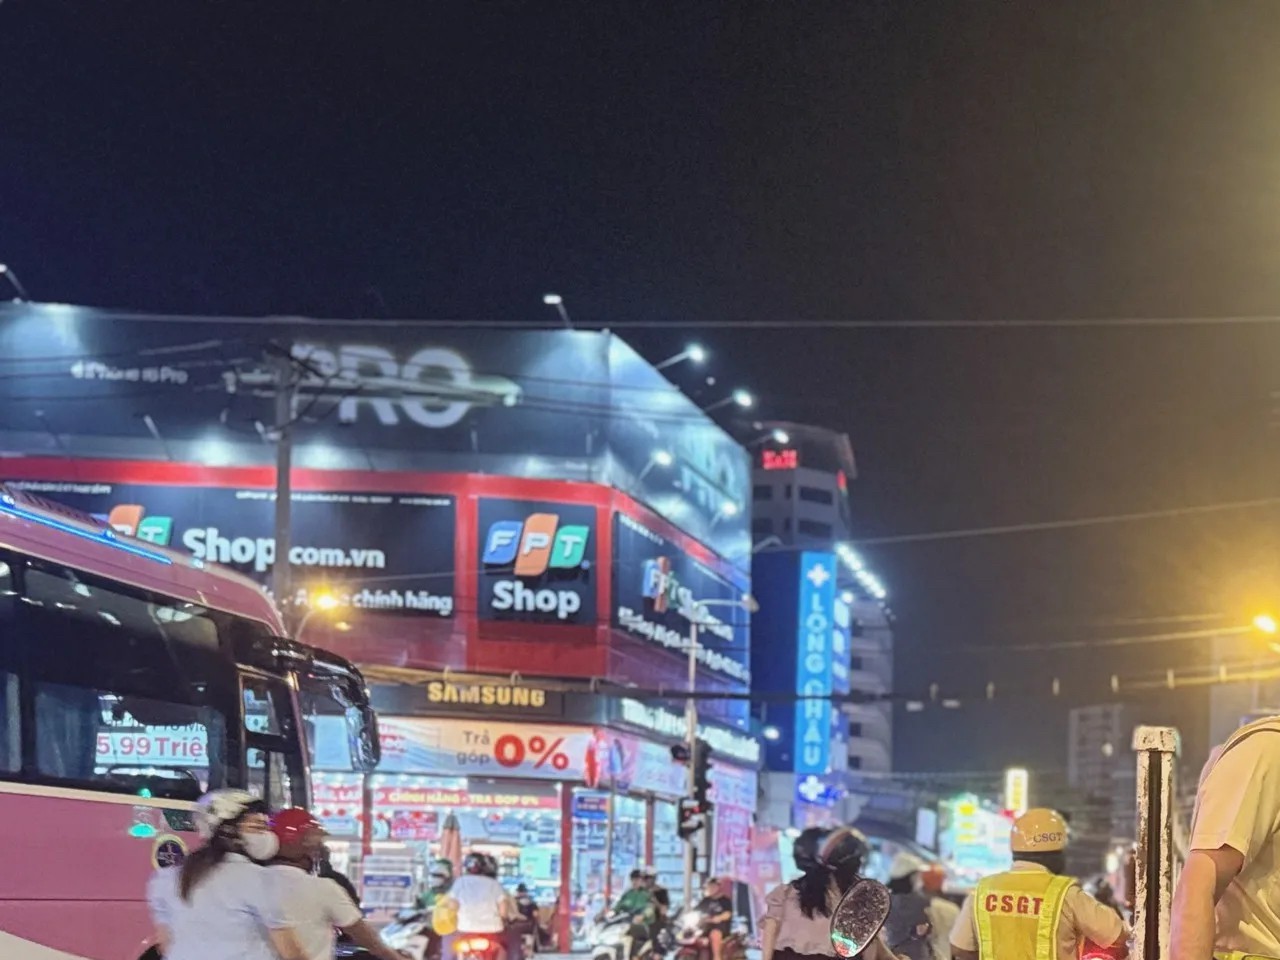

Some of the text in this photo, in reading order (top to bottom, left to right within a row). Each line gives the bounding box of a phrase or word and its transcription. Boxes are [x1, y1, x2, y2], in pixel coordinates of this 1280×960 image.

[491, 580, 581, 619] Shop
[806, 593, 828, 674] LONG
[427, 682, 546, 707] SAMSUNG
[155, 736, 208, 763] Triệ
[456, 752, 491, 765] góp
[463, 729, 569, 770] Trả 0%
[1033, 831, 1063, 843] CSGT
[985, 893, 1044, 915] CSGT
